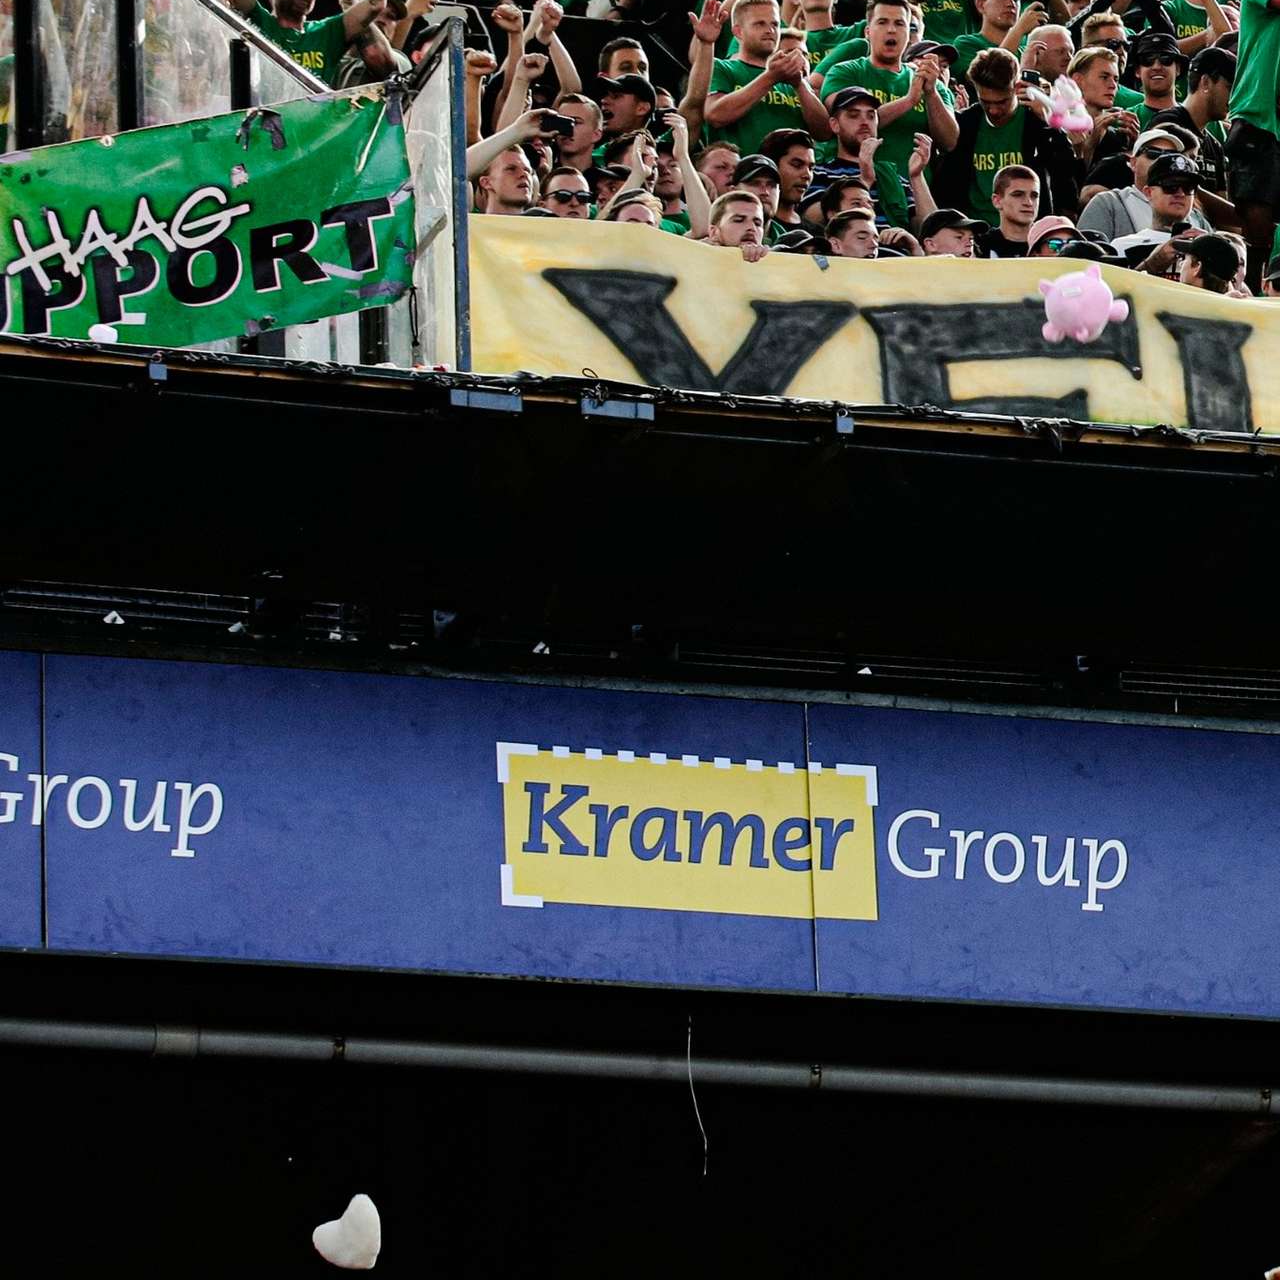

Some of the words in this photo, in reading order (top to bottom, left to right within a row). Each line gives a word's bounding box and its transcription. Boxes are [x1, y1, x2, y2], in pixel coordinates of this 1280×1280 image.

[974, 153, 995, 171] ARS
[0, 197, 395, 336] PPORT
[8, 186, 251, 292] HAAG
[521, 781, 855, 873] Kramer
[886, 809, 1129, 911] Group
